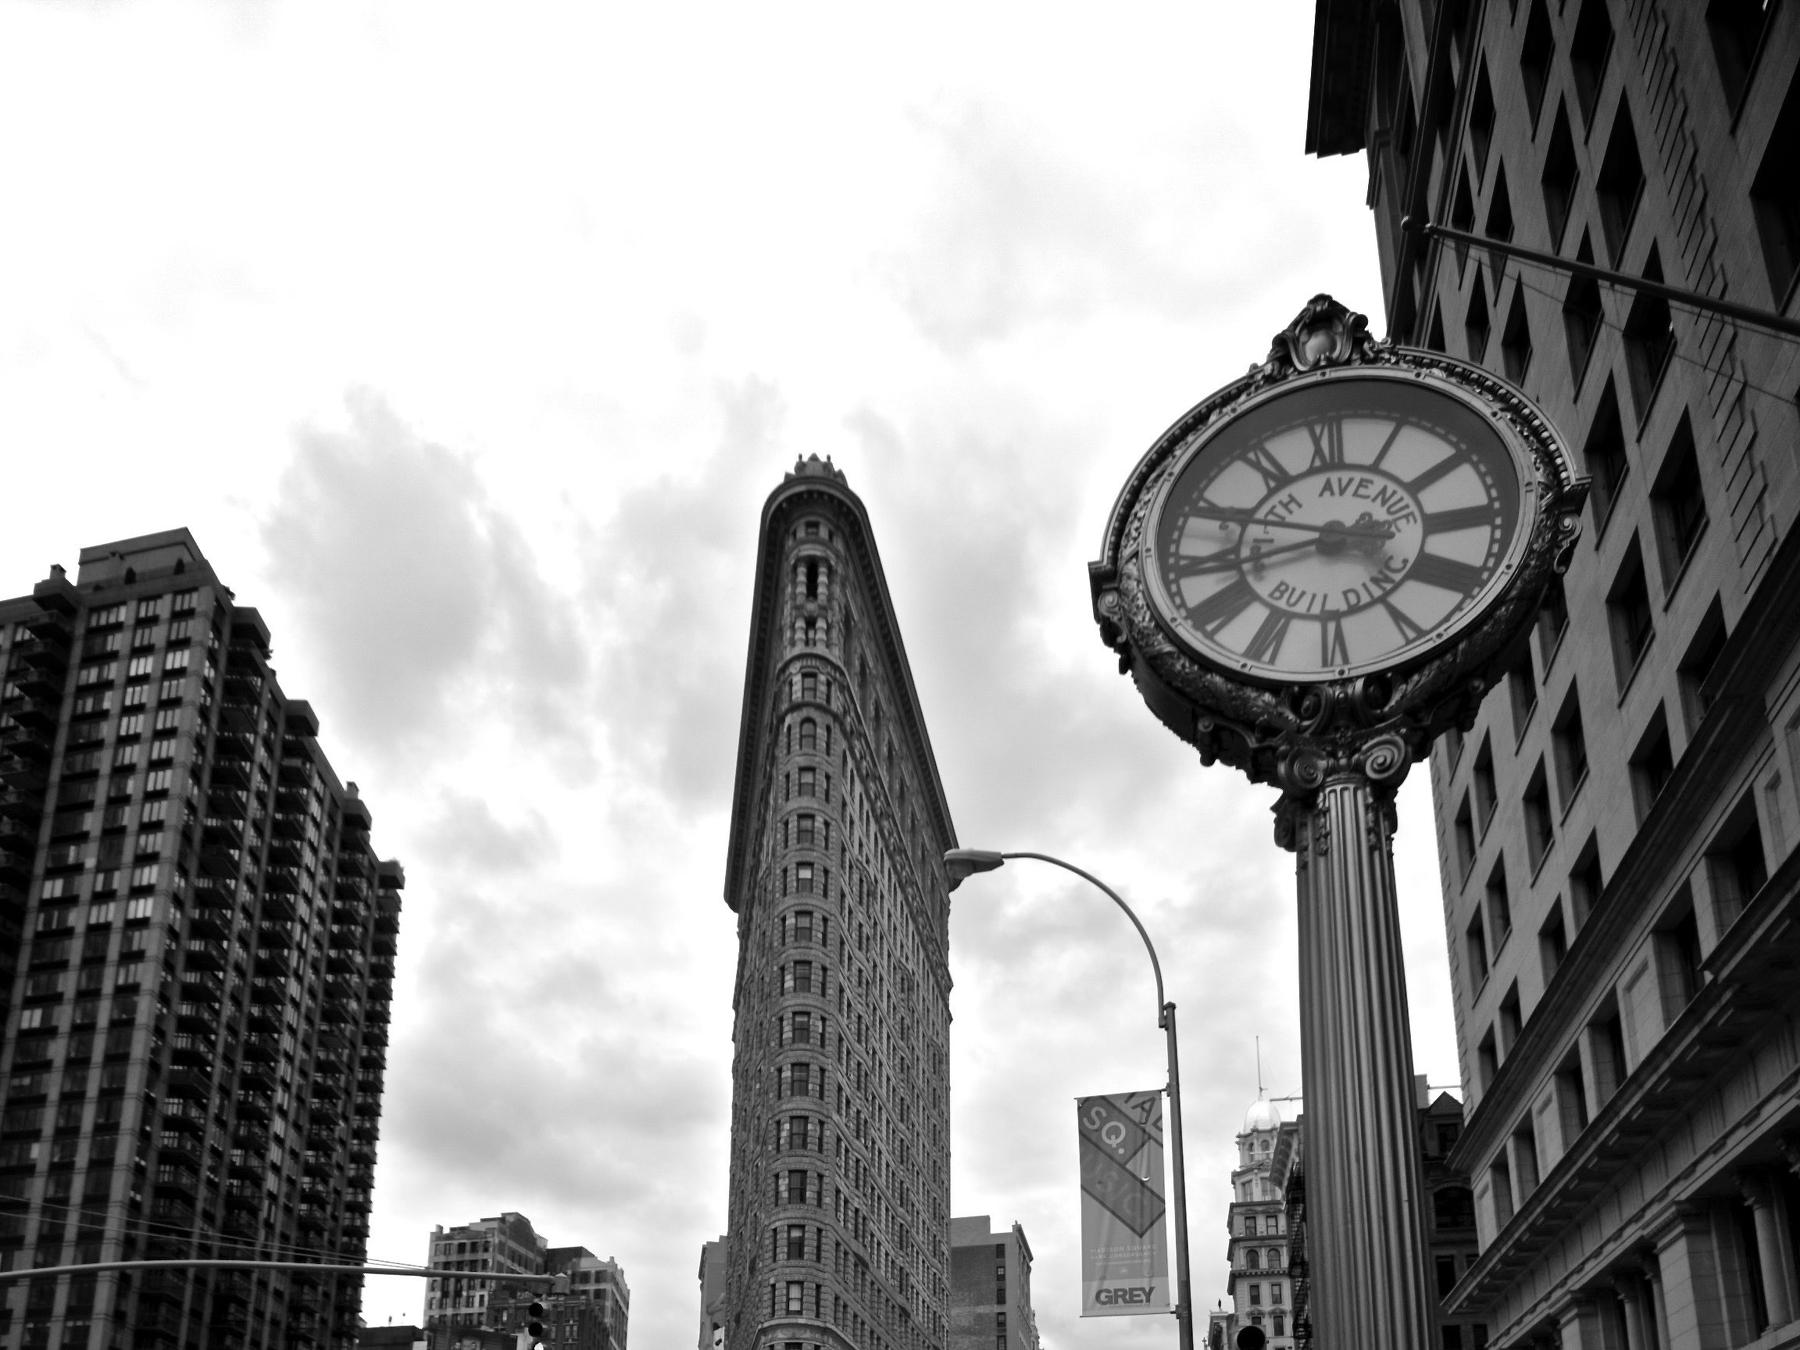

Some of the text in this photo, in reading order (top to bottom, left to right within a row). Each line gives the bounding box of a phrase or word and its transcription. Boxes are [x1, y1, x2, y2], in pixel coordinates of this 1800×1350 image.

[1318, 477, 1417, 533] AVENUE
[1267, 554, 1409, 613] BUILDING
[1082, 1106, 1127, 1155] SQ.
[1127, 1243, 1157, 1252] SQUARE
[1095, 1286, 1156, 1306] GREY
